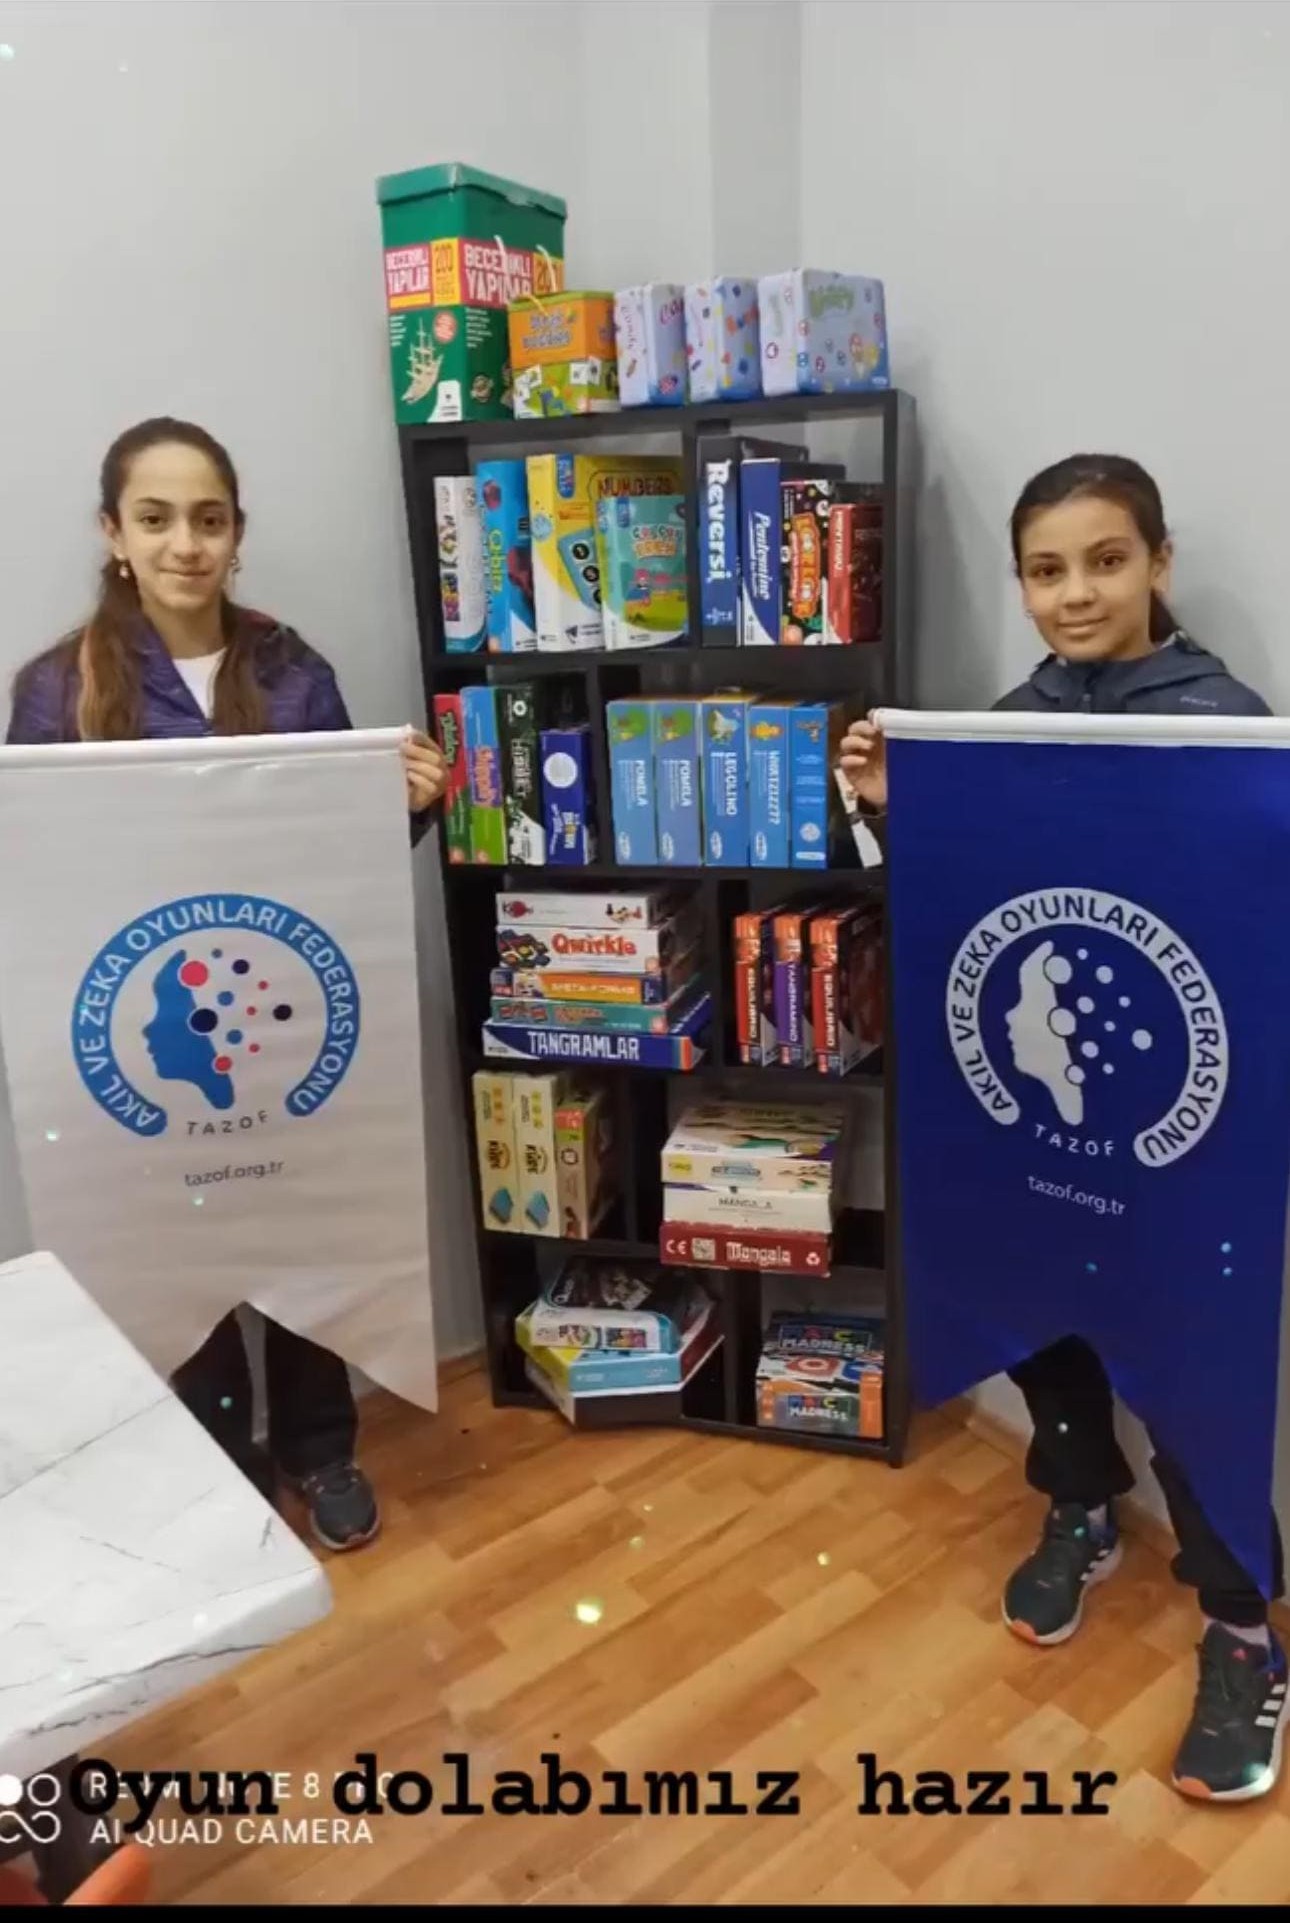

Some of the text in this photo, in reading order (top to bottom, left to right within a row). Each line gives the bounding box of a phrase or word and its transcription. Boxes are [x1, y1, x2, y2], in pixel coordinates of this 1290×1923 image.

[706, 459, 732, 580] Reversi
[552, 932, 637, 955] Qwirkle
[79, 899, 355, 1129] AKIL VE ZEKA OYUNLARI FEDERASYONU
[951, 894, 1221, 1161] AKIL VE ZEKA OYUNLARI FEDERASYONU
[527, 1031, 640, 1060] TANGRAMLAR
[186, 1109, 269, 1136] TAZOF
[1033, 1122, 1115, 1157] TAZOF
[184, 1159, 285, 1188] tazof.org.tr
[1027, 1175, 1126, 1217] tazof.org.tr
[726, 1241, 791, 1267] Mangala
[789, 1406, 848, 1422] MADNESS
